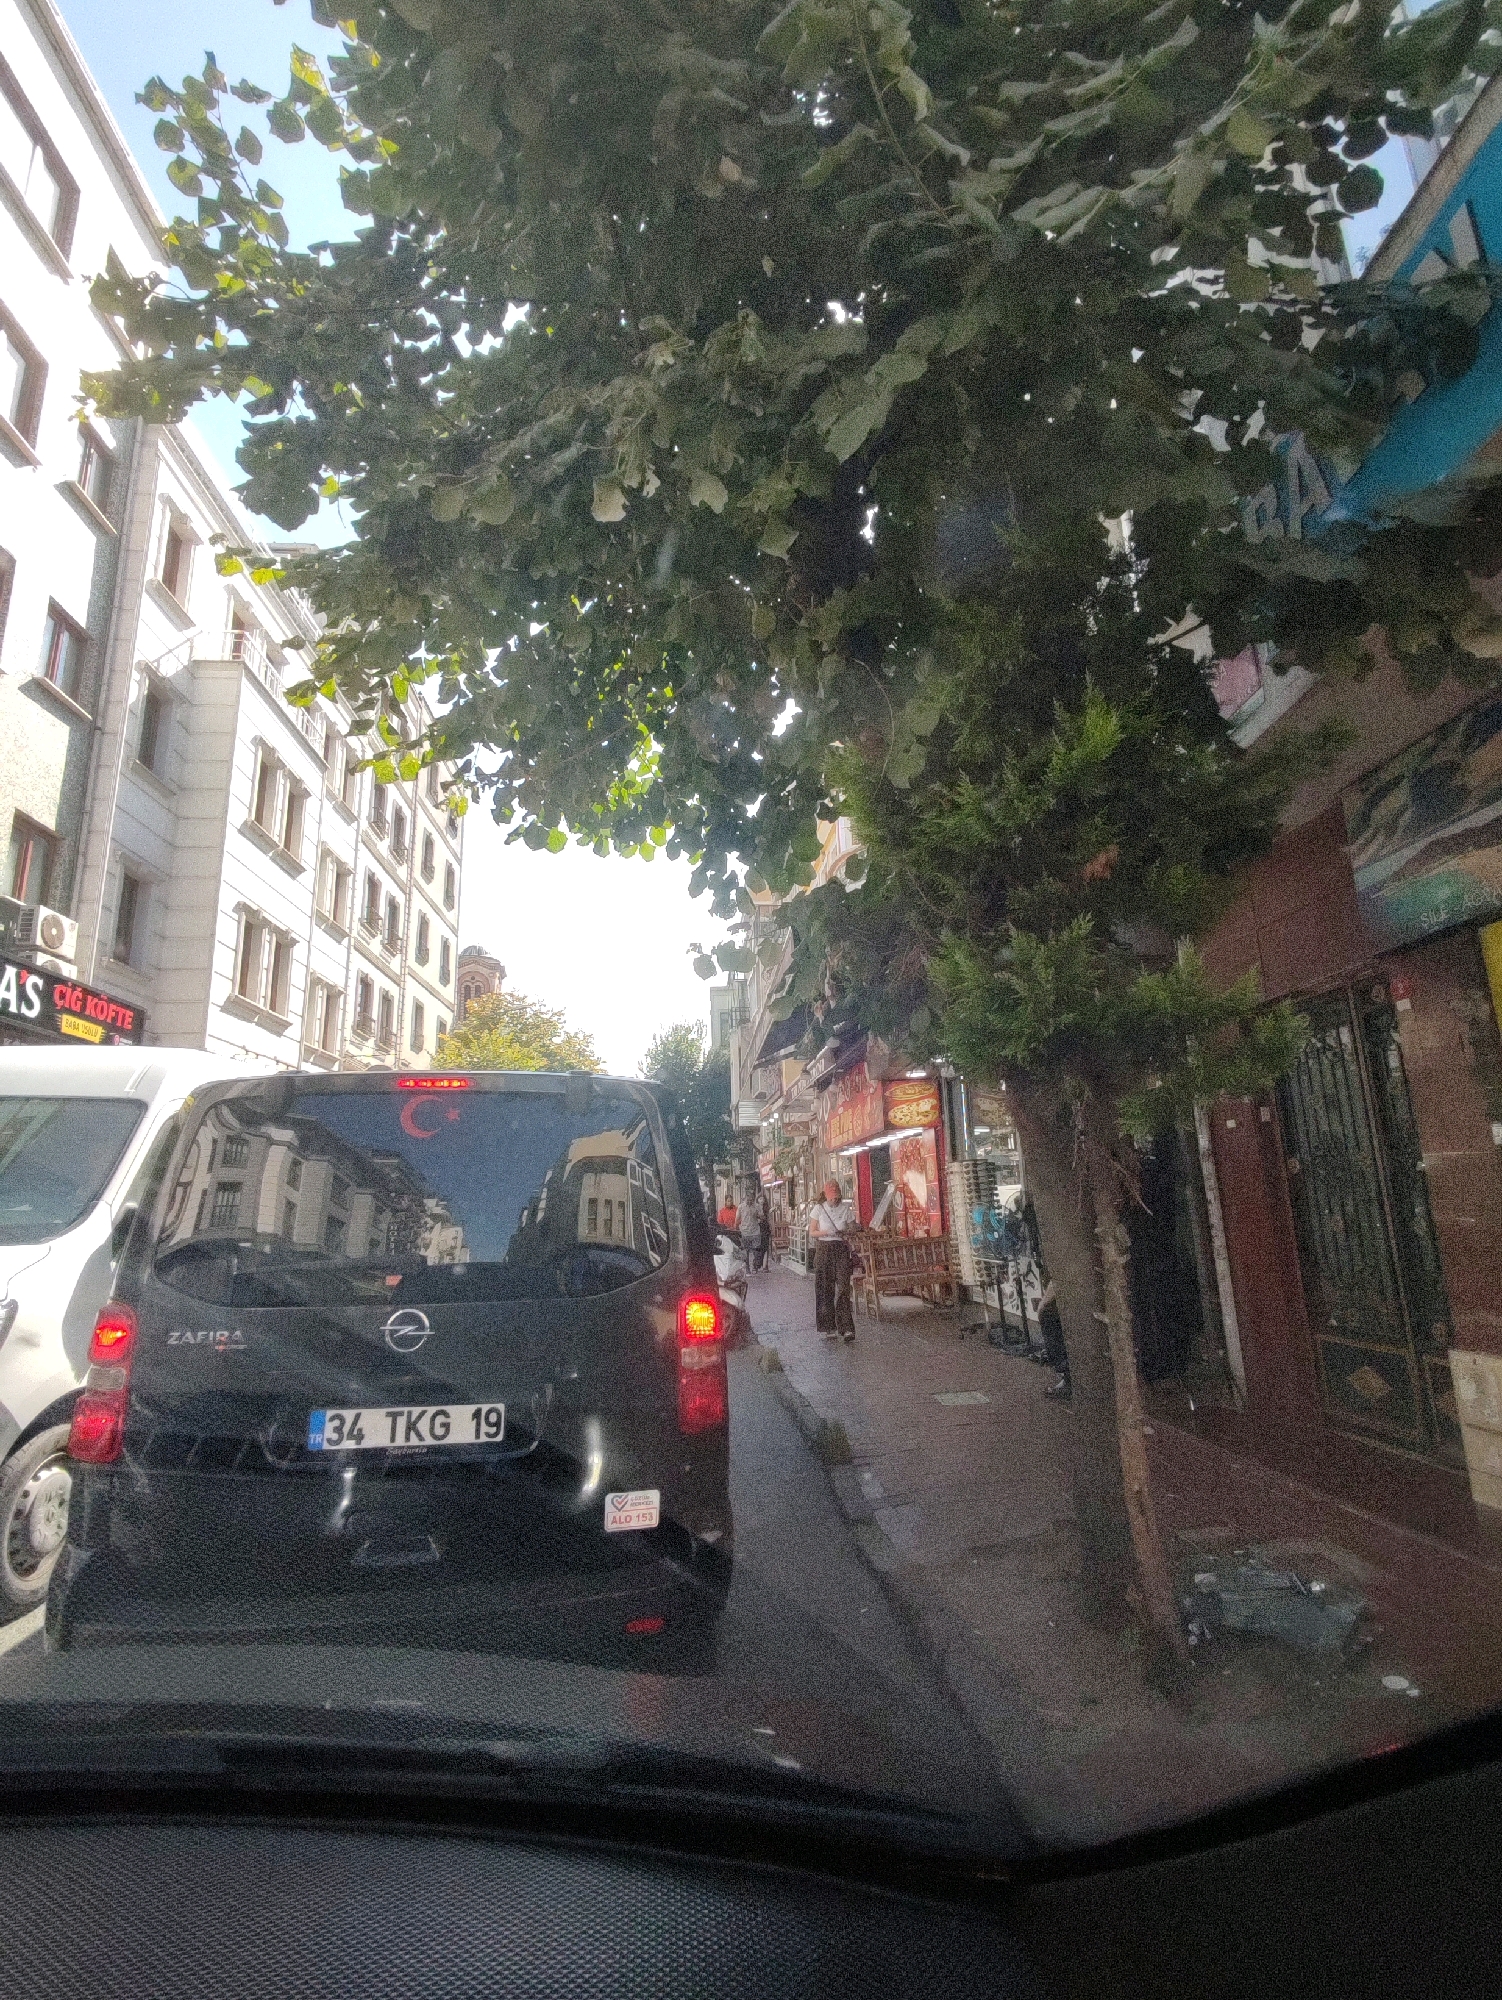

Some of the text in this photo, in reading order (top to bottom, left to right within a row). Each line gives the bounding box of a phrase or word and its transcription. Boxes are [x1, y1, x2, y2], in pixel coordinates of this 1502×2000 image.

[53, 981, 134, 1029] ÇİĞ KÖFTE
[167, 1330, 244, 1344] ZAFIRA
[326, 1406, 502, 1446] 34 TKG 19
[309, 1433, 323, 1443] TR
[611, 1512, 653, 1524] ALO 153
